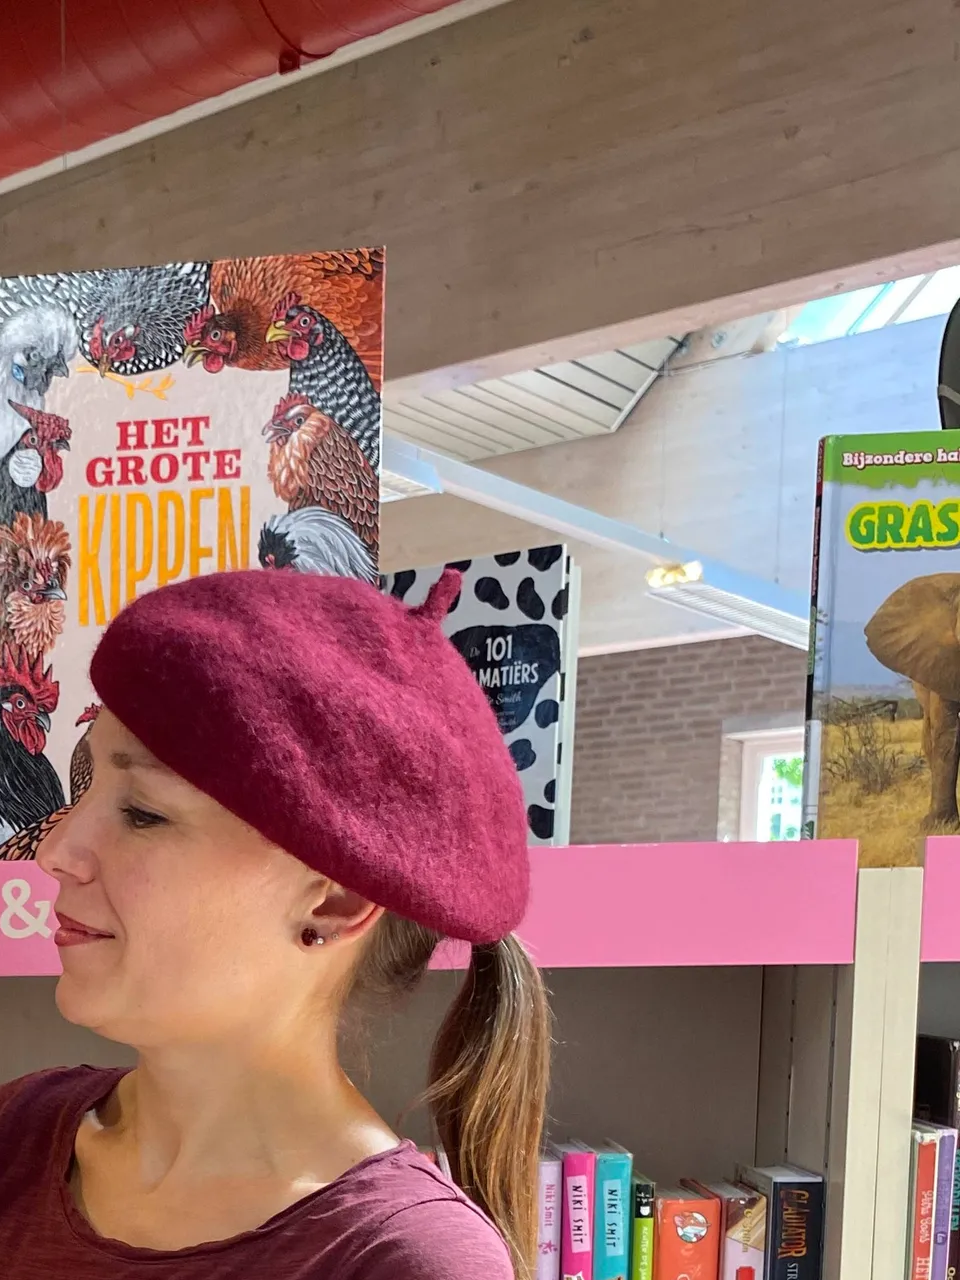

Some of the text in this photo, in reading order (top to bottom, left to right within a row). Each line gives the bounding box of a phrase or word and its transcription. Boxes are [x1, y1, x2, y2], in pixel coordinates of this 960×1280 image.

[116, 416, 210, 451] HET
[85, 449, 241, 487] GROTE
[842, 450, 933, 470] Bijzondere
[847, 501, 960, 547] GRAS
[486, 634, 512, 661] 101
[472, 661, 539, 688] MATIËRS
[0, 878, 53, 940] &
[545, 1184, 555, 1227] Niki Smit
[778, 1189, 810, 1260] GLADIATOR
[916, 1257, 930, 1280] HET
